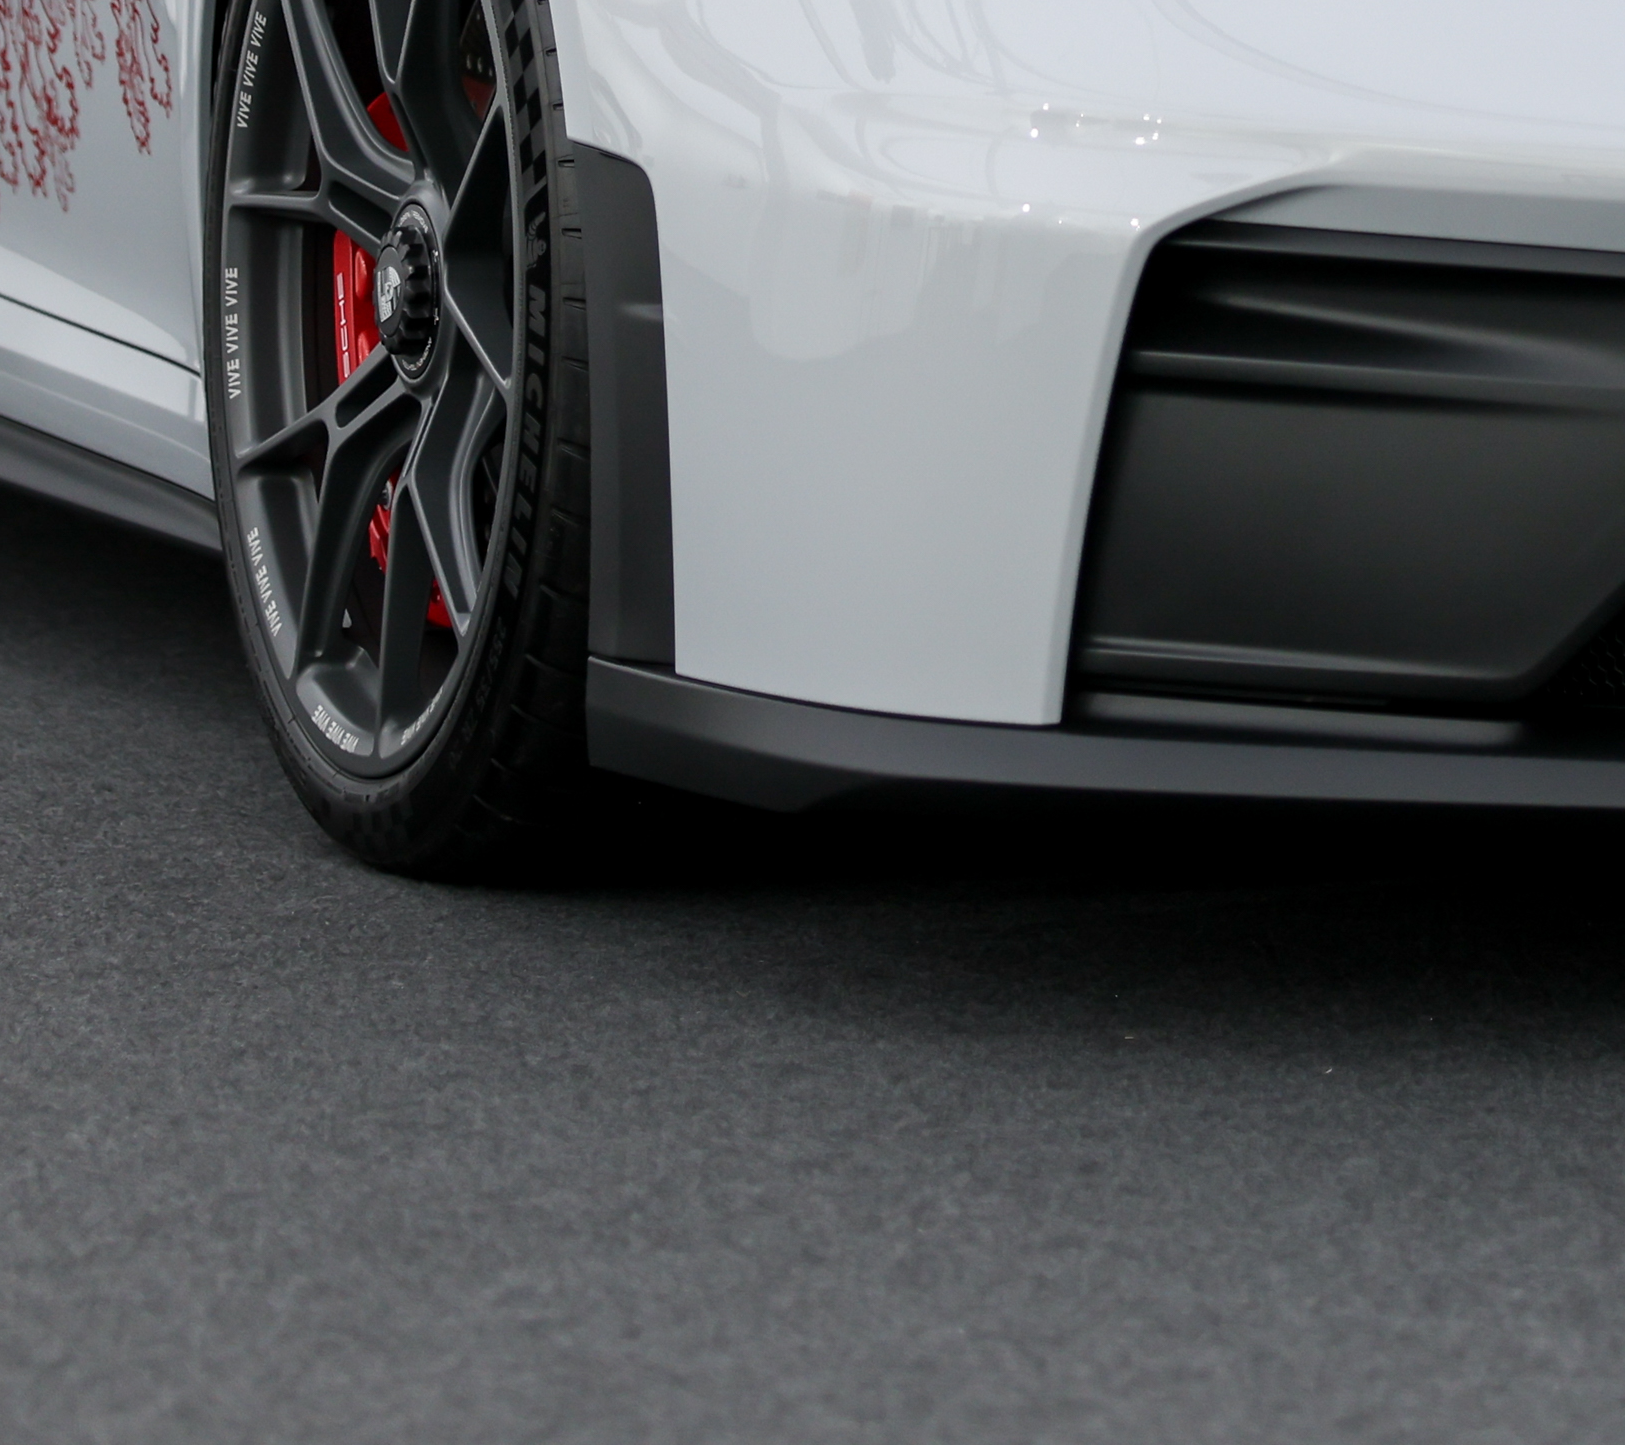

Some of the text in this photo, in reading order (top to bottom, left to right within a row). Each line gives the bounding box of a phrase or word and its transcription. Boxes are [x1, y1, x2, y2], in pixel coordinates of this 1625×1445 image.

[237, 11, 267, 128] VIVE VIVE VIVE
[225, 267, 242, 400] VIVE VIVE VIVE
[504, 284, 548, 601] MICHELIN
[246, 526, 282, 637] VIVE VIVE VIVE
